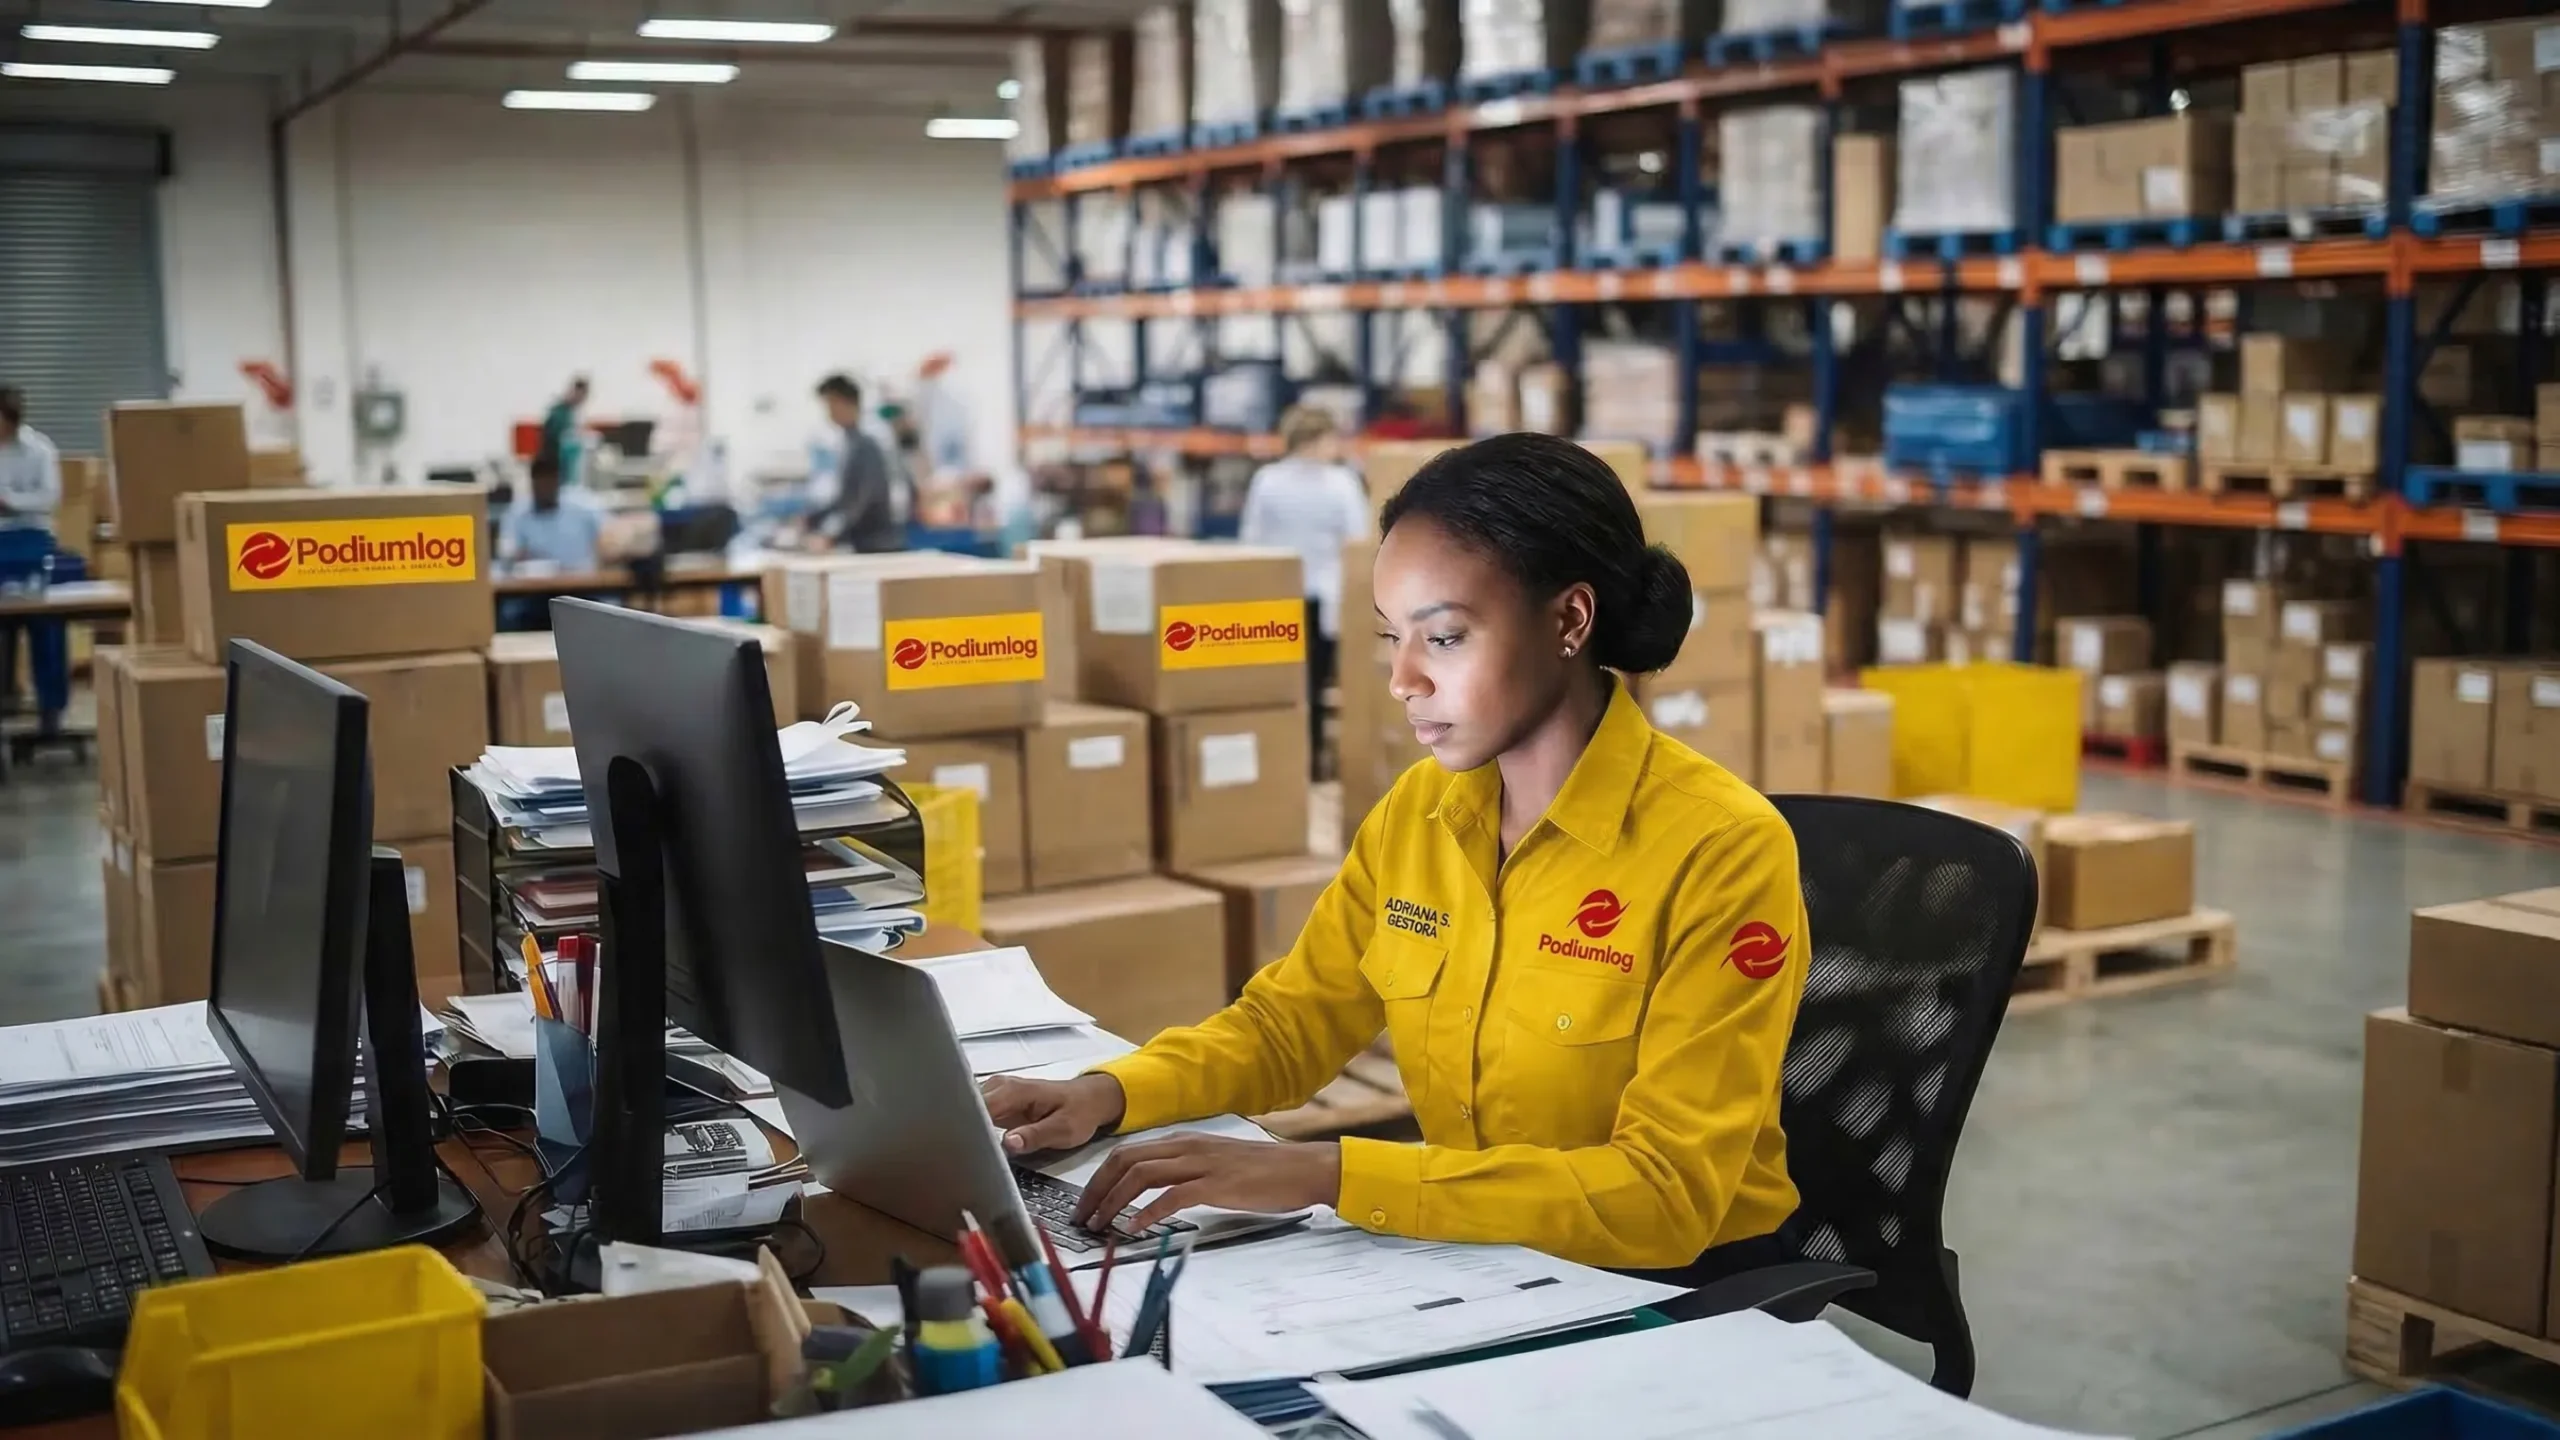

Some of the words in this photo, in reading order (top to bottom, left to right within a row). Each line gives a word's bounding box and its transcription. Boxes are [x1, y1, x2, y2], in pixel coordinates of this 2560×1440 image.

[297, 532, 465, 567] Podiumlog
[1199, 620, 1299, 641] Podiumlog
[930, 636, 1038, 660] Podiumlog
[1385, 897, 1438, 924] ADRIANA
[1440, 913, 1451, 927] S.
[1388, 914, 1437, 938] GESTORA
[1538, 933, 1634, 973] Podiumlog
